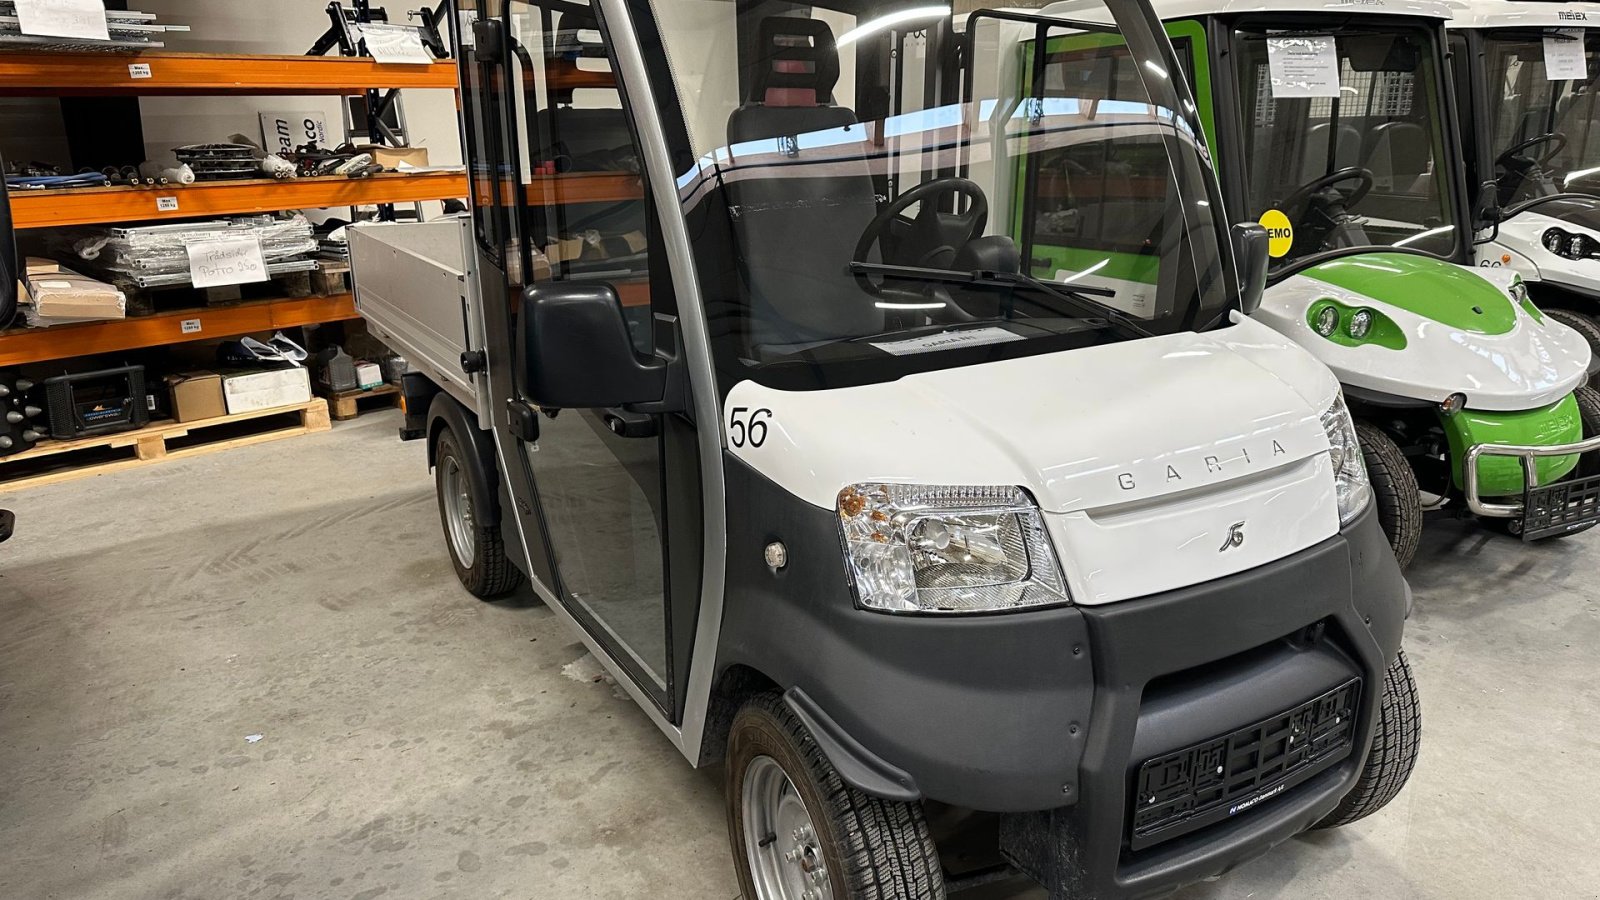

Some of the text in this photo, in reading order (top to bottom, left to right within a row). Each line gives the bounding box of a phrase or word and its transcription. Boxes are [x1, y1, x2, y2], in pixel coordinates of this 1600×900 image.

[1558, 10, 1587, 20] melex
[275, 119, 292, 159] eam
[316, 120, 325, 144] Nordic
[1268, 228, 1291, 238] EMO
[730, 407, 772, 448] 56
[1118, 440, 1286, 490] GARIA
